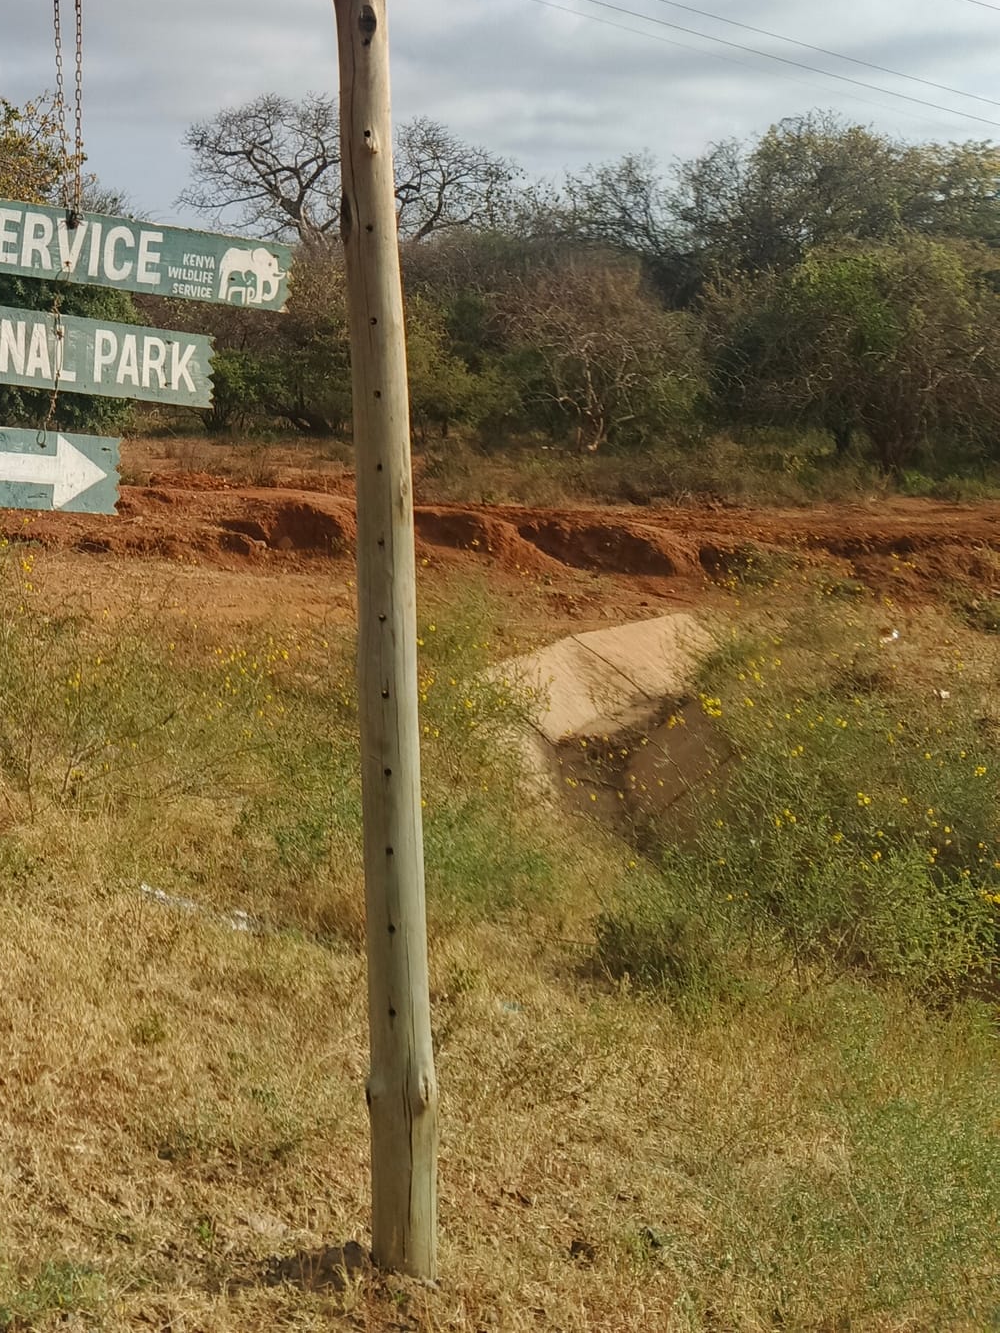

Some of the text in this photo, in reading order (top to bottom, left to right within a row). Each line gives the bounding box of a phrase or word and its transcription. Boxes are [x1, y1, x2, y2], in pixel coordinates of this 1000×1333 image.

[183, 253, 215, 269] KENYA
[168, 266, 214, 284] WILDLIFE
[172, 282, 213, 298] SERVICE
[93, 328, 197, 392] PARK
